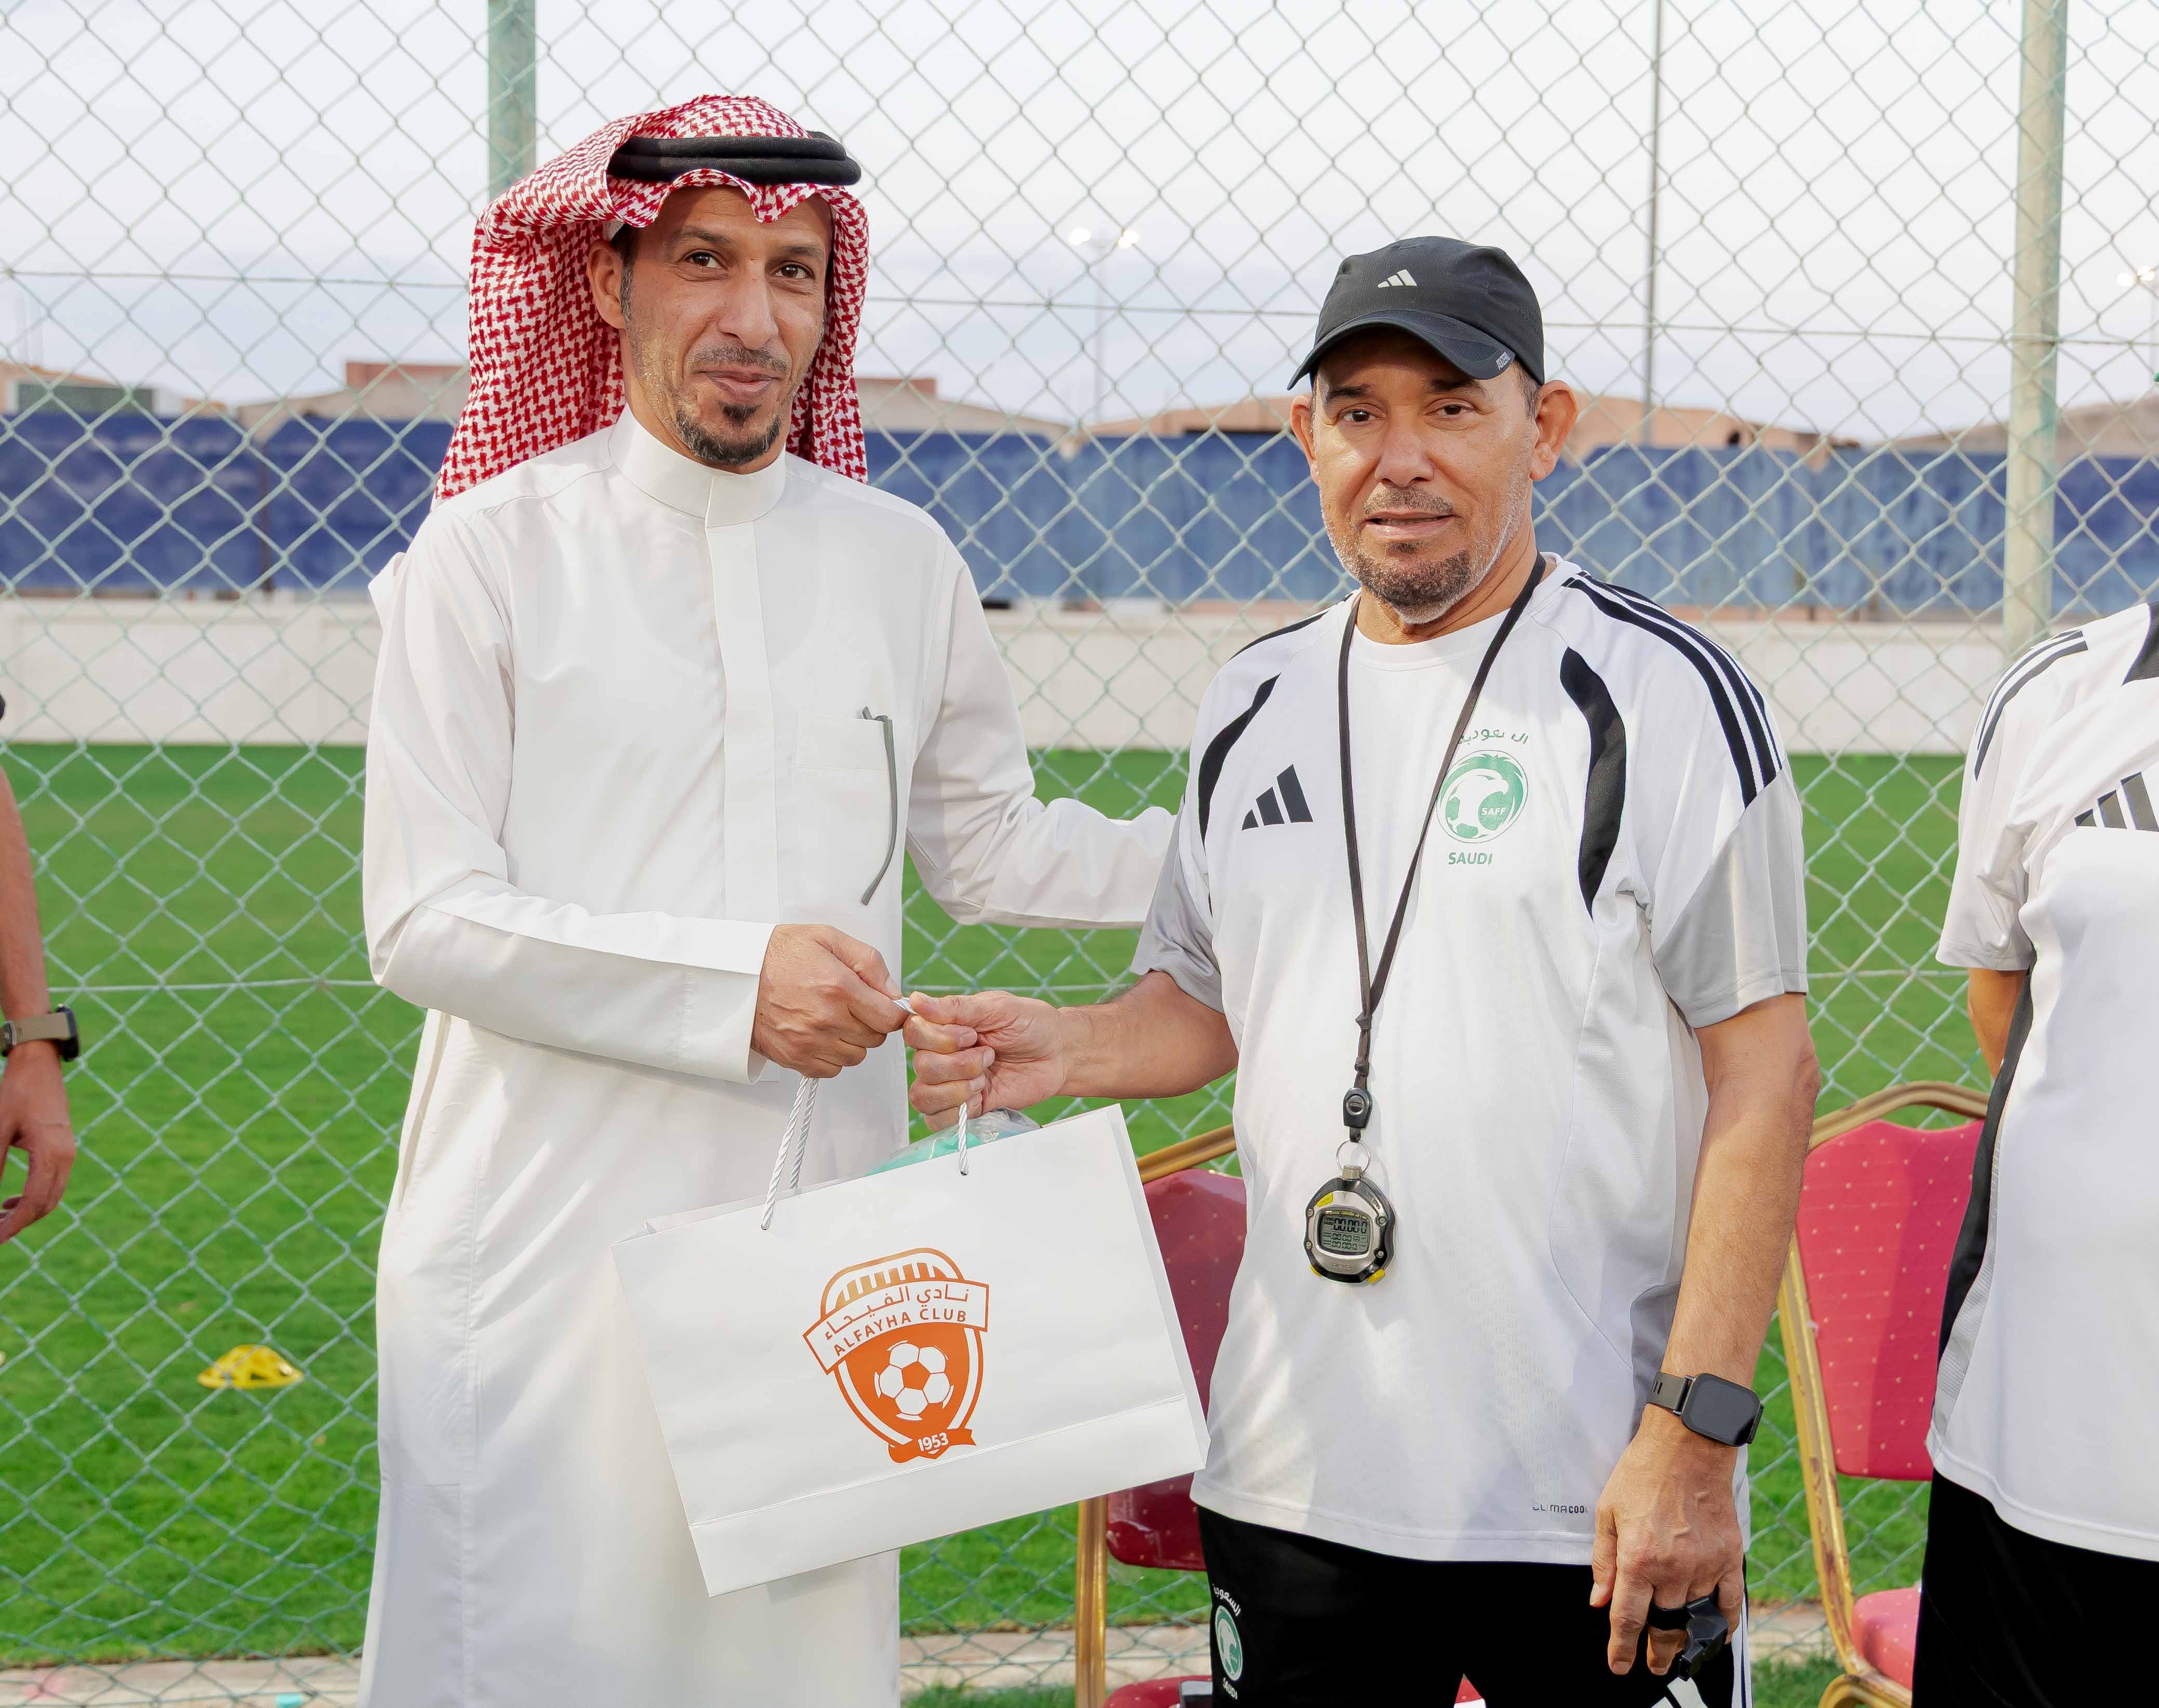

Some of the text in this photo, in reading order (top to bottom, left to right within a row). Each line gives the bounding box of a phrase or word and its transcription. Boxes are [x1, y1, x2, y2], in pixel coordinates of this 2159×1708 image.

[1481, 807, 1506, 816] SAFF
[1448, 852, 1493, 865] SAUDI
[825, 1283, 969, 1340] نادي الفيحاء
[833, 1308, 966, 1357] ALFAYHA CLUB
[917, 1432, 949, 1452] 1953
